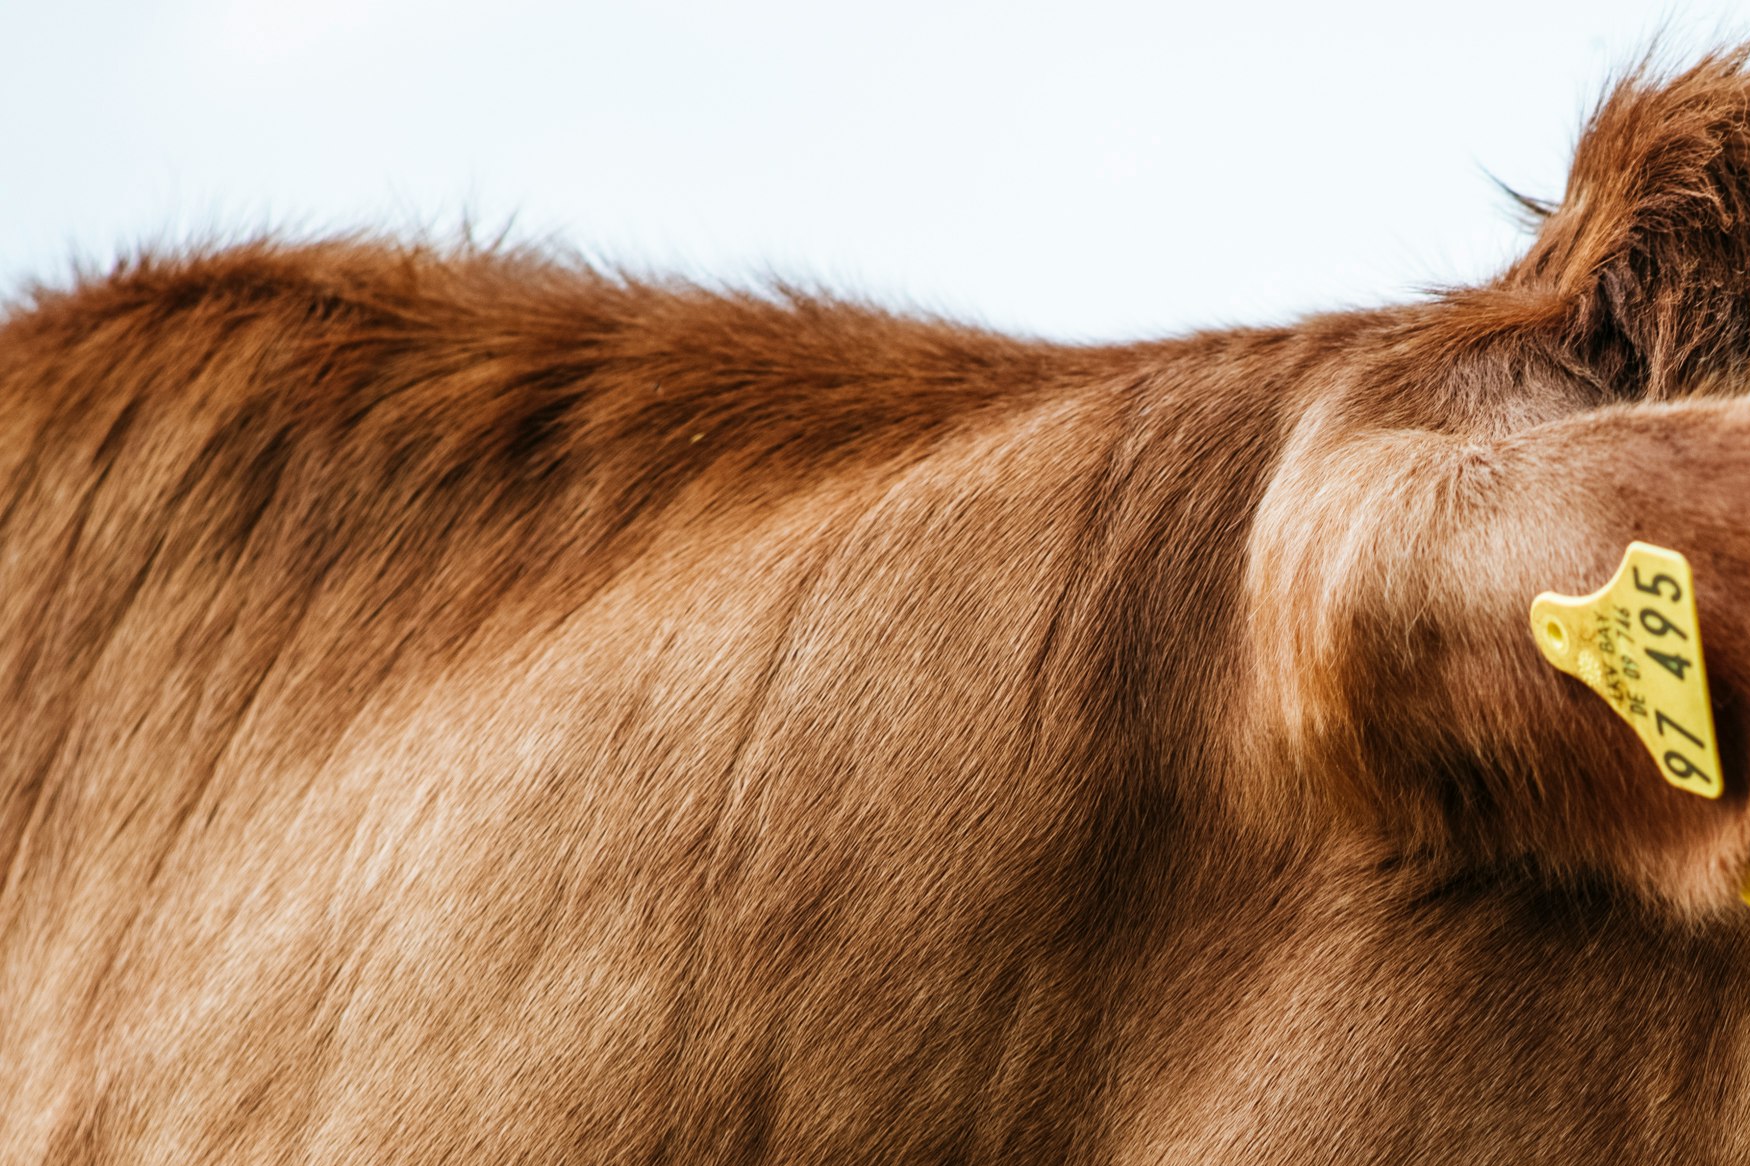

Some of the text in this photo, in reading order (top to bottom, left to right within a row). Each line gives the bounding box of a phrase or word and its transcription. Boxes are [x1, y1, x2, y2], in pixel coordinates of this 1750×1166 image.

[1594, 611, 1615, 654] BAY
[1613, 604, 1648, 717] DE 09 746
[1633, 566, 1711, 784] 97 495
